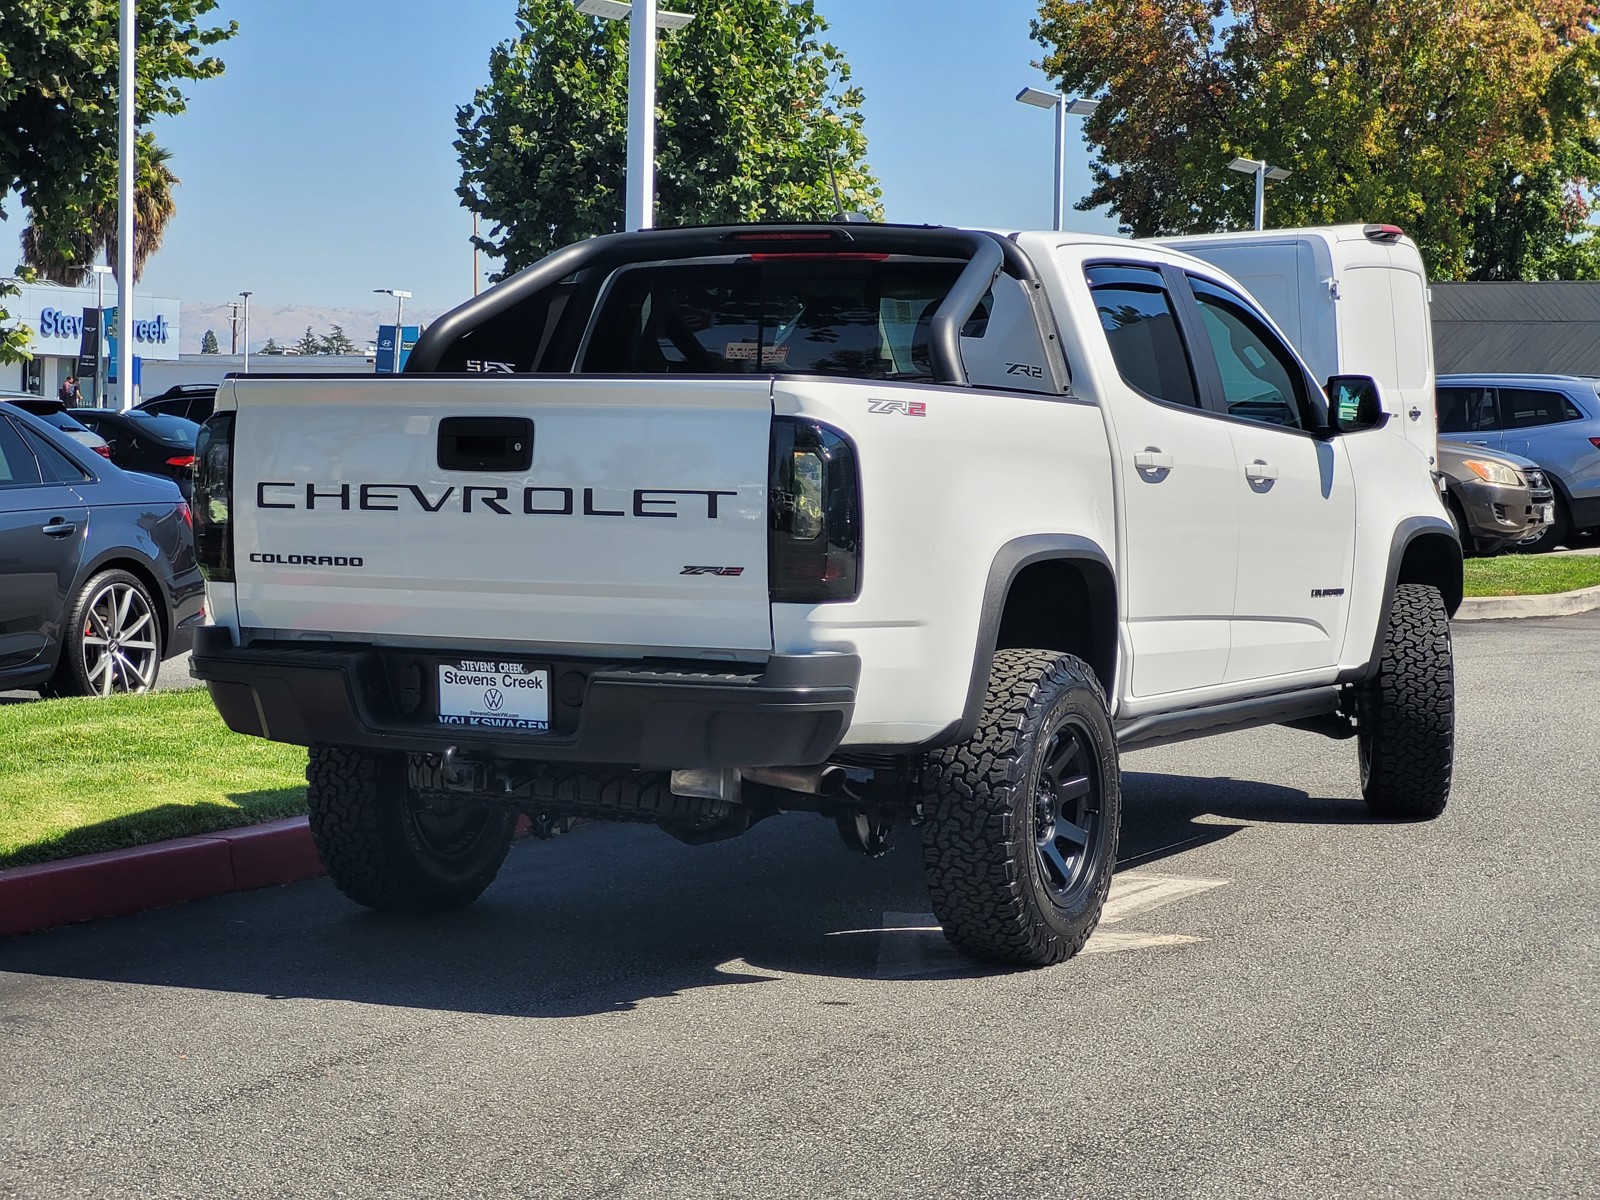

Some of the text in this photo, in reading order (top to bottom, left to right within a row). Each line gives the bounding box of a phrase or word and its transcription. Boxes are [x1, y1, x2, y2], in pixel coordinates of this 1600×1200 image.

[41, 307, 84, 339] Stev
[133, 314, 170, 344] reek
[1005, 362, 1043, 378] ZR2
[868, 398, 926, 417] ZR2
[257, 482, 737, 518] CHEVROLET
[250, 553, 363, 566] COLORADO
[679, 565, 745, 576] ZR2
[461, 660, 524, 674] STEVENS CREEK
[444, 671, 543, 689] Stevens Creek
[469, 710, 519, 718] StevensCreekVW.com
